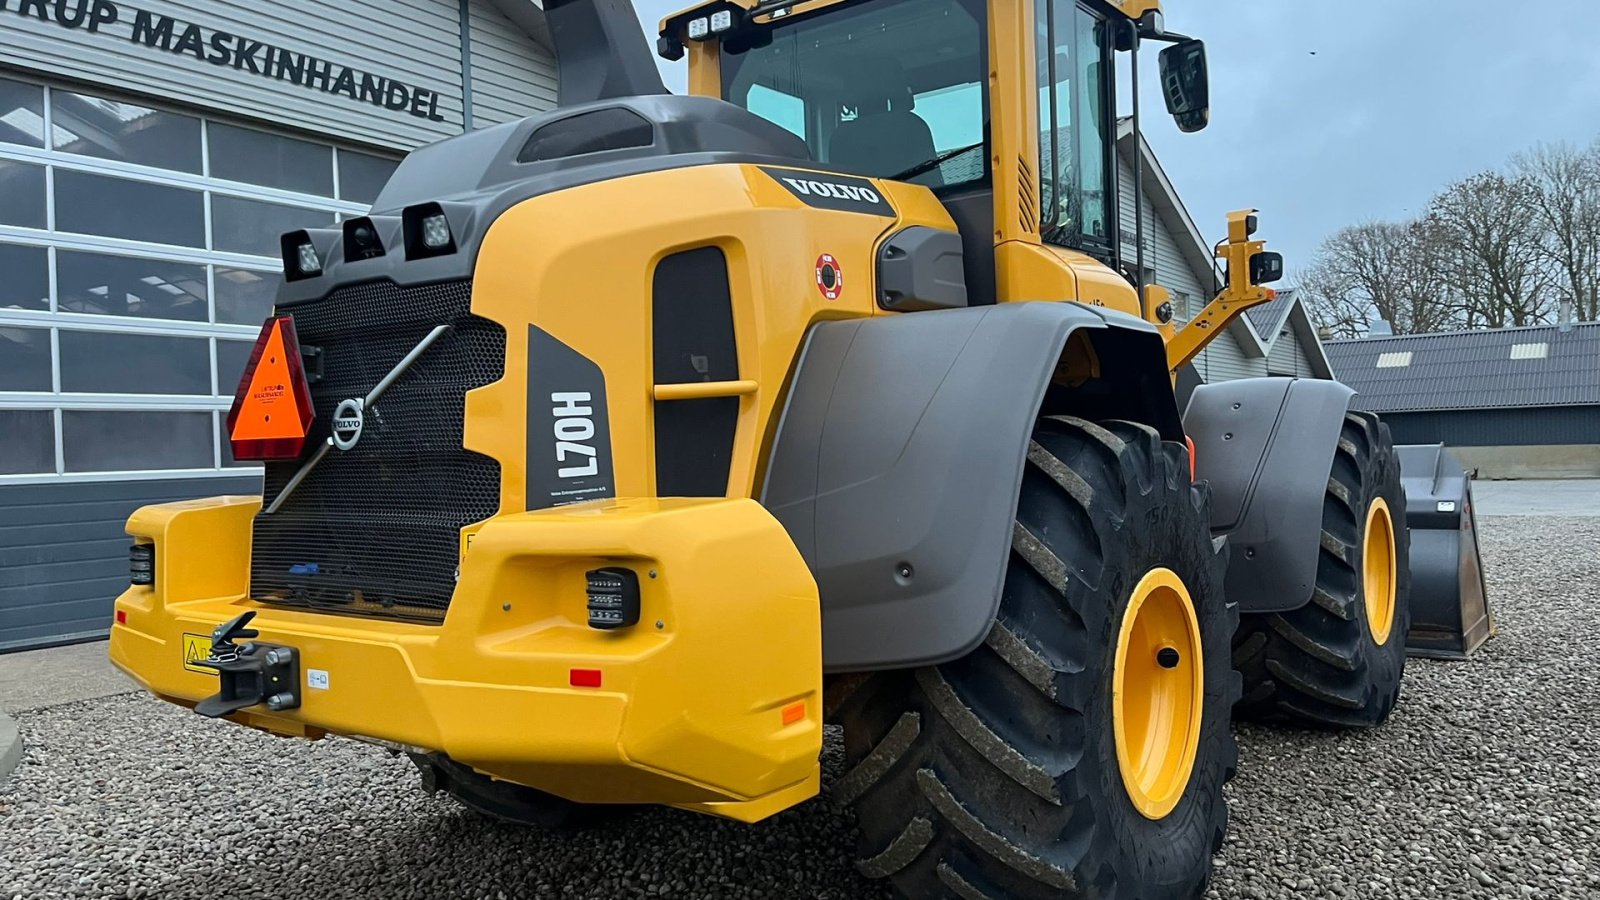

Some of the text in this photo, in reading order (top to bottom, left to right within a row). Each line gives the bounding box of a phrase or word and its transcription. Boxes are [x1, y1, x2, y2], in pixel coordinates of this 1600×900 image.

[0, 0, 444, 122] RUP MASKINHANDEL
[781, 177, 880, 204] VOLVO
[333, 420, 361, 429] VOLVO
[551, 391, 598, 478] L70H
